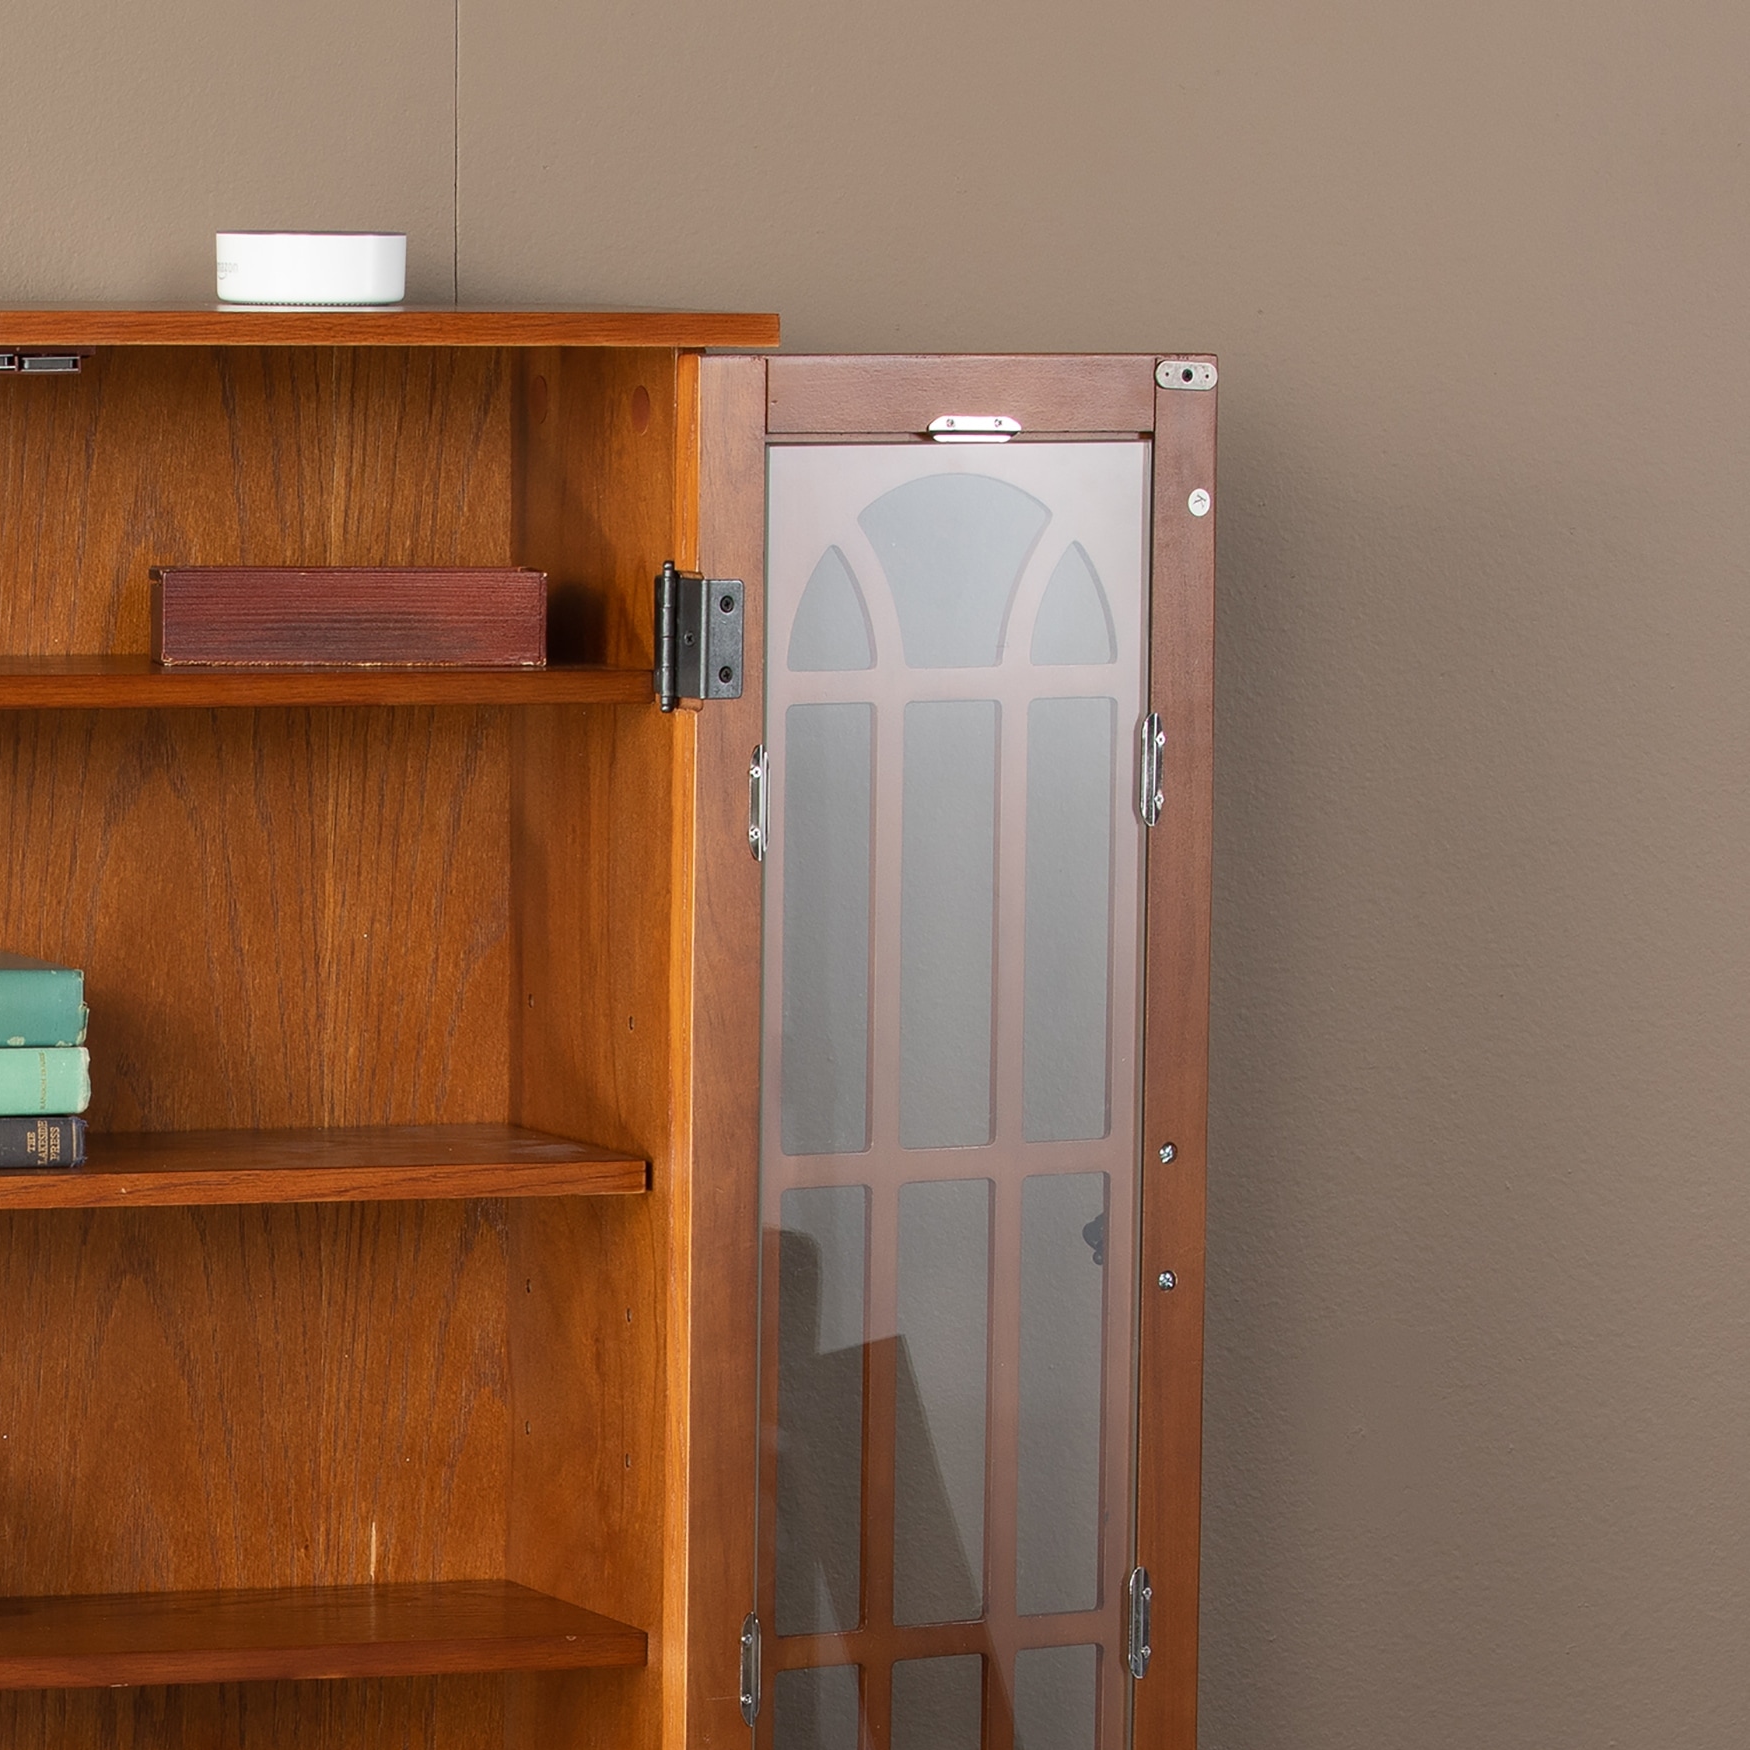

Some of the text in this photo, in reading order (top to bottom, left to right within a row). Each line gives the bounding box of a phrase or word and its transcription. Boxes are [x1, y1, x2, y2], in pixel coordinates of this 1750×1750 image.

[27, 1131, 36, 1153] THE
[37, 1120, 48, 1165] LAKESIDE
[49, 1126, 61, 1161] PRESS
